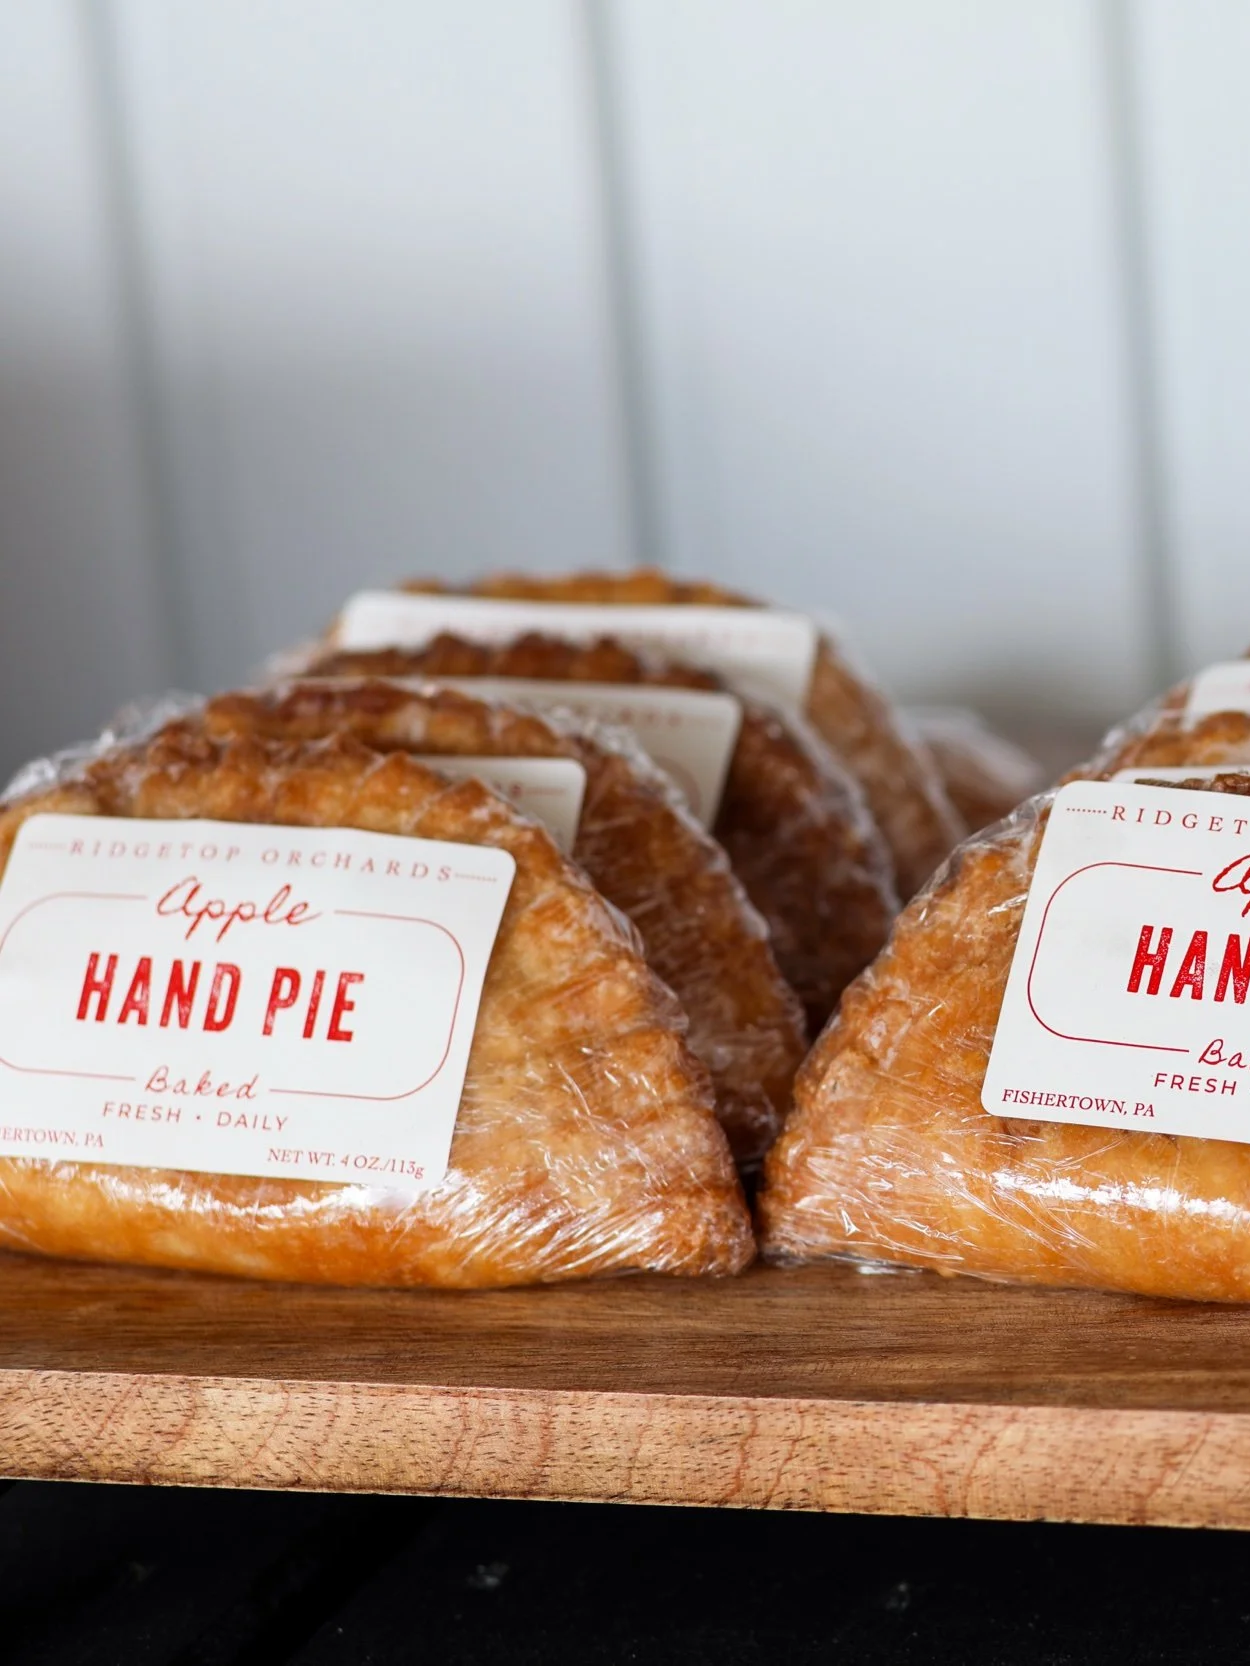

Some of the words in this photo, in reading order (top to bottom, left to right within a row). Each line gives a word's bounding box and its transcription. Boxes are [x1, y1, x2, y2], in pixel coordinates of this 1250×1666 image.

[70, 839, 240, 862] RIDGETOP
[261, 848, 452, 882] ORCHARDS
[157, 876, 318, 943] Apple
[76, 952, 241, 1032] HAND
[262, 967, 364, 1042] PIE
[145, 1066, 258, 1099] Baked
[1154, 1073, 1236, 1095] FRESH
[102, 1102, 181, 1123] FRESH
[217, 1112, 287, 1131] DAILY
[1001, 1088, 1128, 1116] FISHERTOWN,
[1133, 1103, 1154, 1117] PA
[0, 1128, 78, 1146] ERTOWN,
[84, 1133, 103, 1148] PA
[268, 1148, 303, 1164] NET
[308, 1152, 334, 1166] WT.
[341, 1155, 349, 1166] 4
